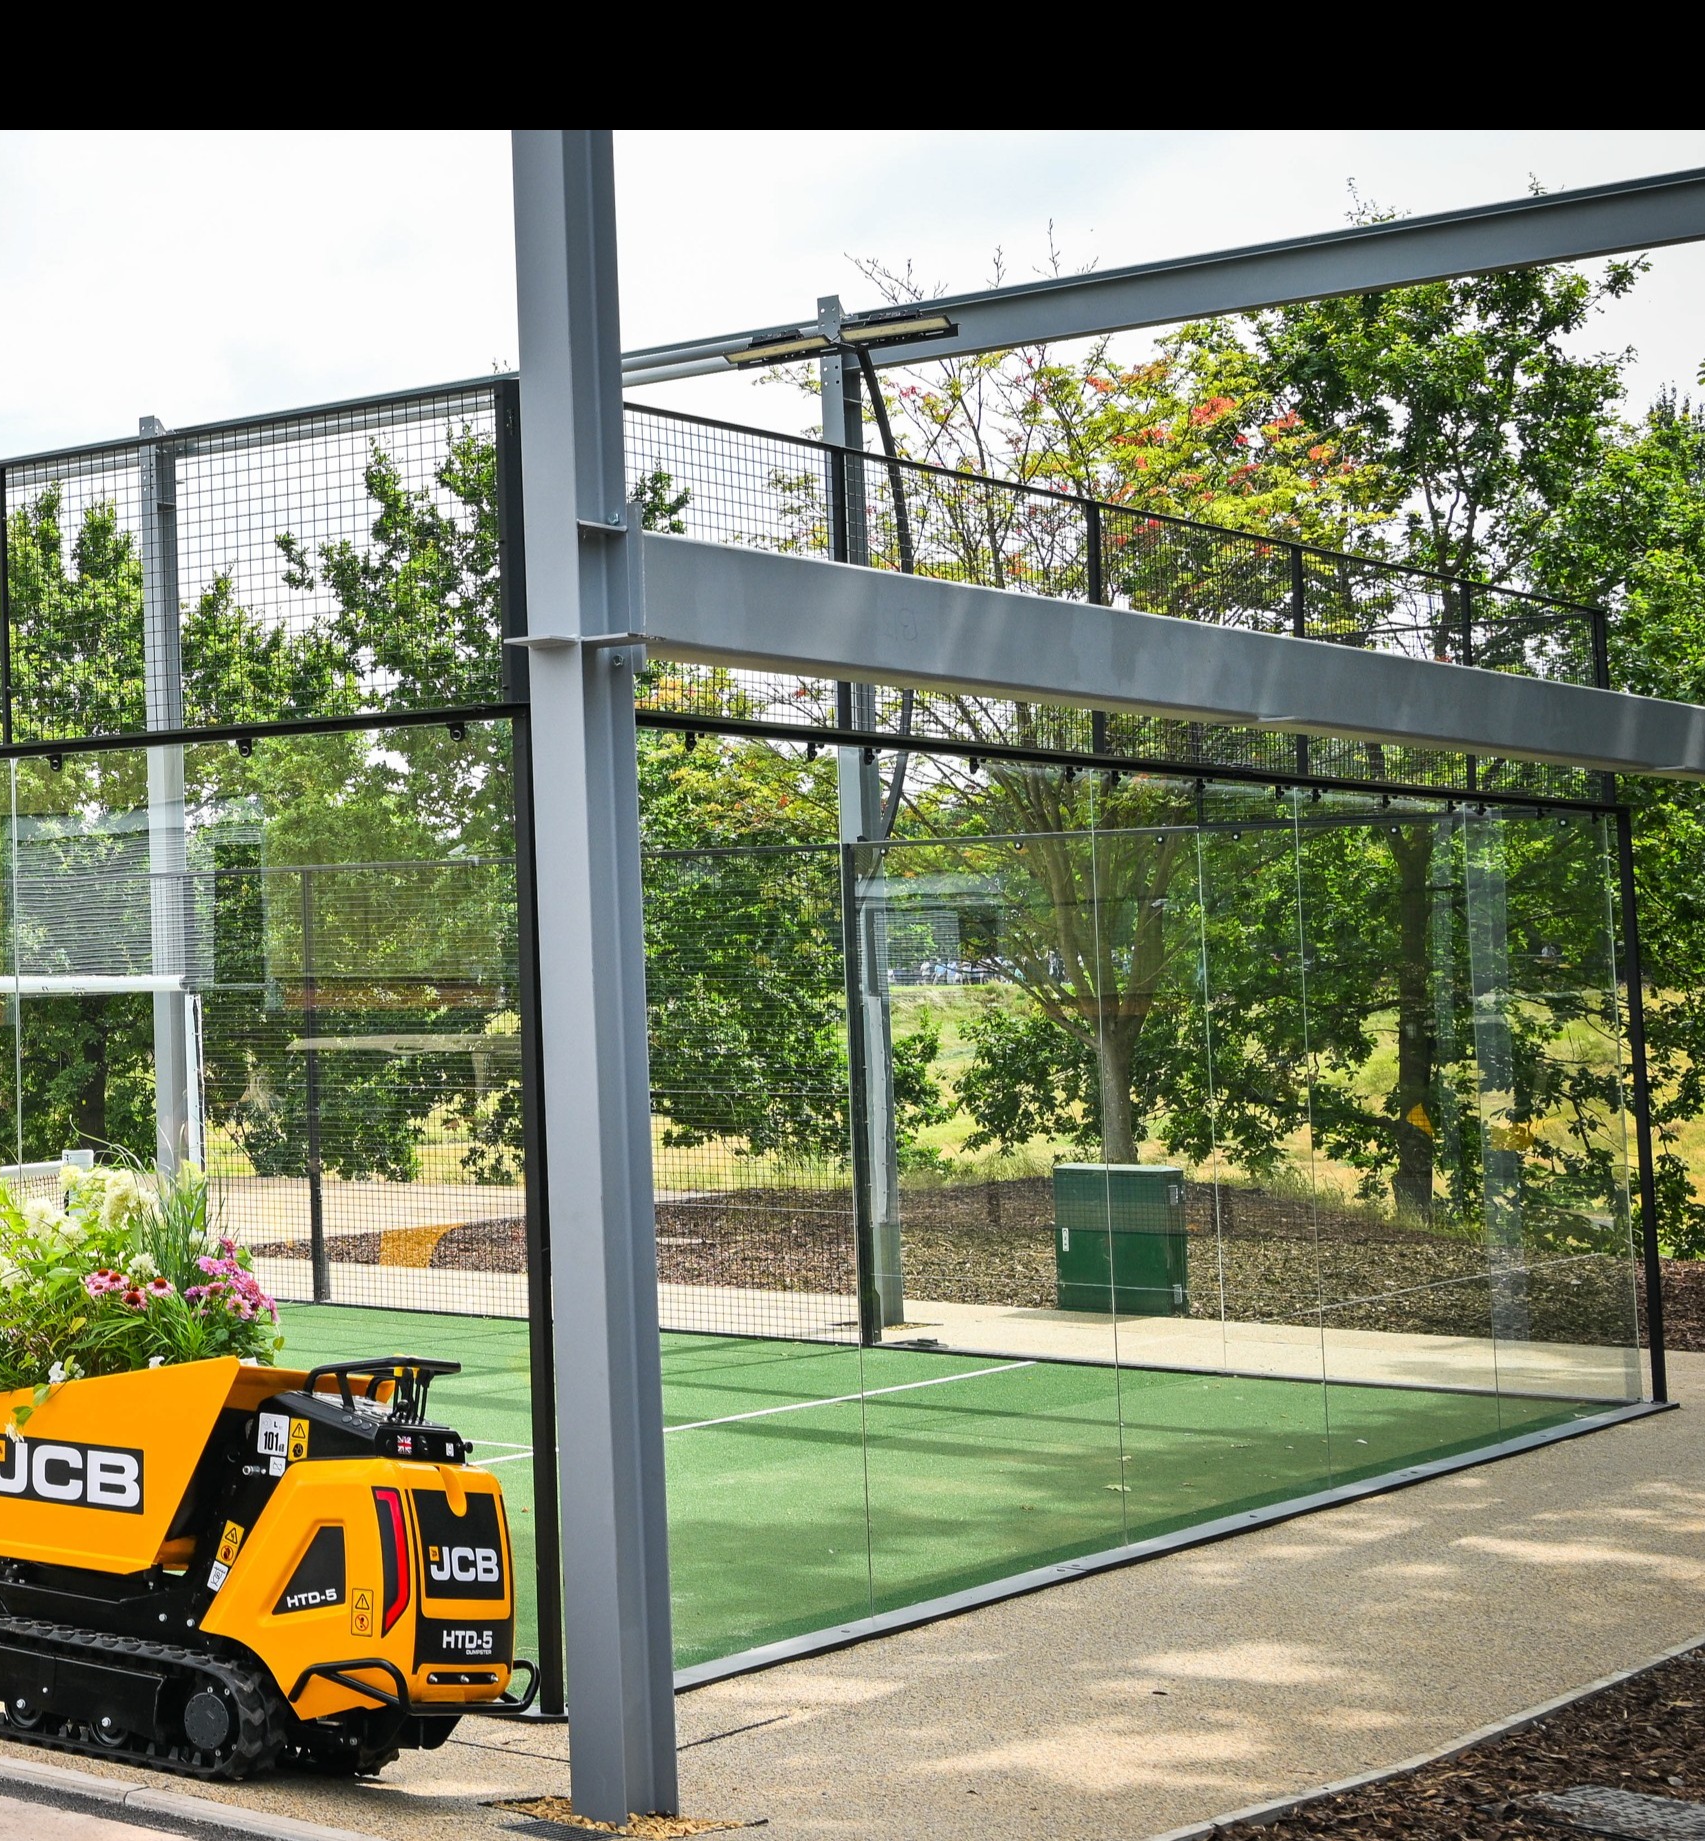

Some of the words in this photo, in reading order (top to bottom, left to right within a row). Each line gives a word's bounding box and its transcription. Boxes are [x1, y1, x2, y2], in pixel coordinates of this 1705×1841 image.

[263, 1431, 279, 1452] 101
[430, 1546, 500, 1582] JCB
[286, 1588, 337, 1608] HTD-5
[442, 1629, 493, 1649] HTD-5
